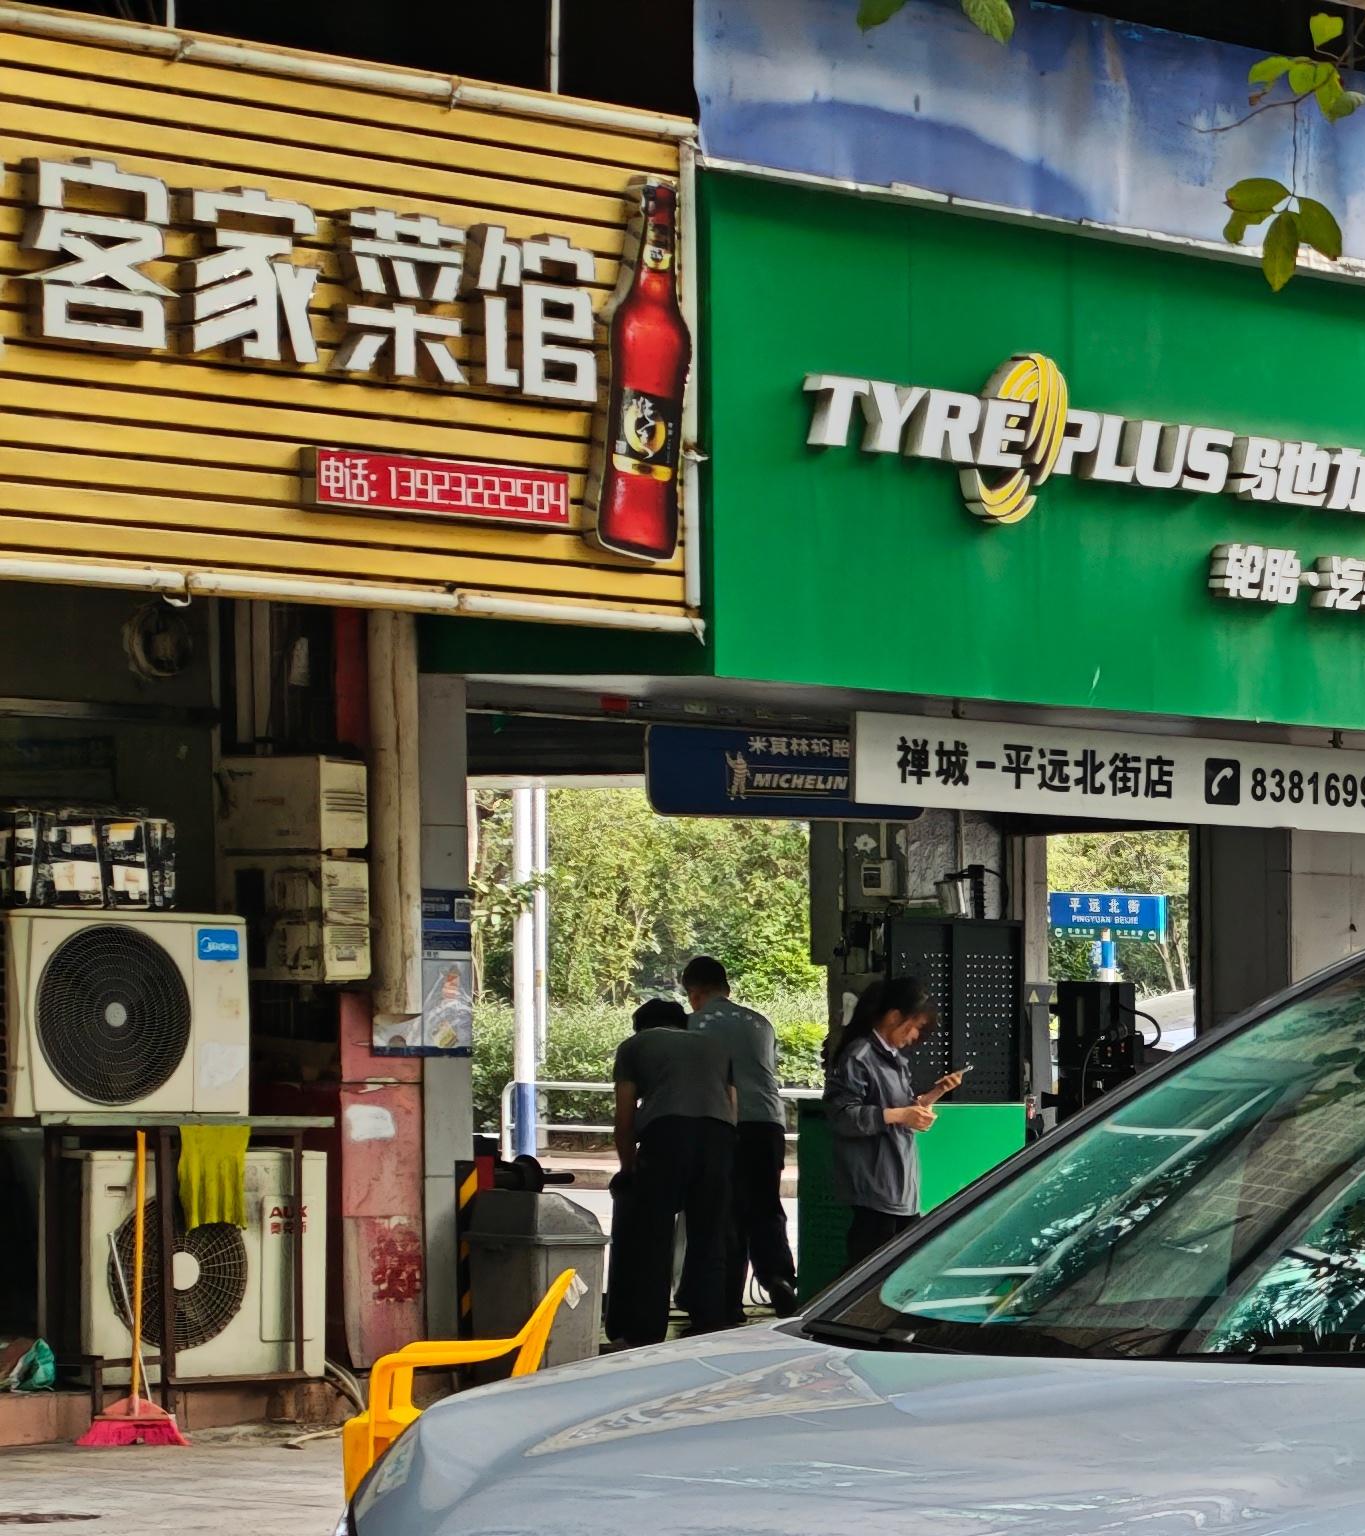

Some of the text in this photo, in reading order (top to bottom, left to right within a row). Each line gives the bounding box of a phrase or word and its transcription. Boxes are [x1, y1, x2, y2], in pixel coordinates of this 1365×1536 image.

[22, 157, 598, 402] 客家菜馆
[387, 464, 567, 516] 13923222584
[753, 773, 849, 791] MICHELIN
[1069, 897, 1141, 915] 平远北街
